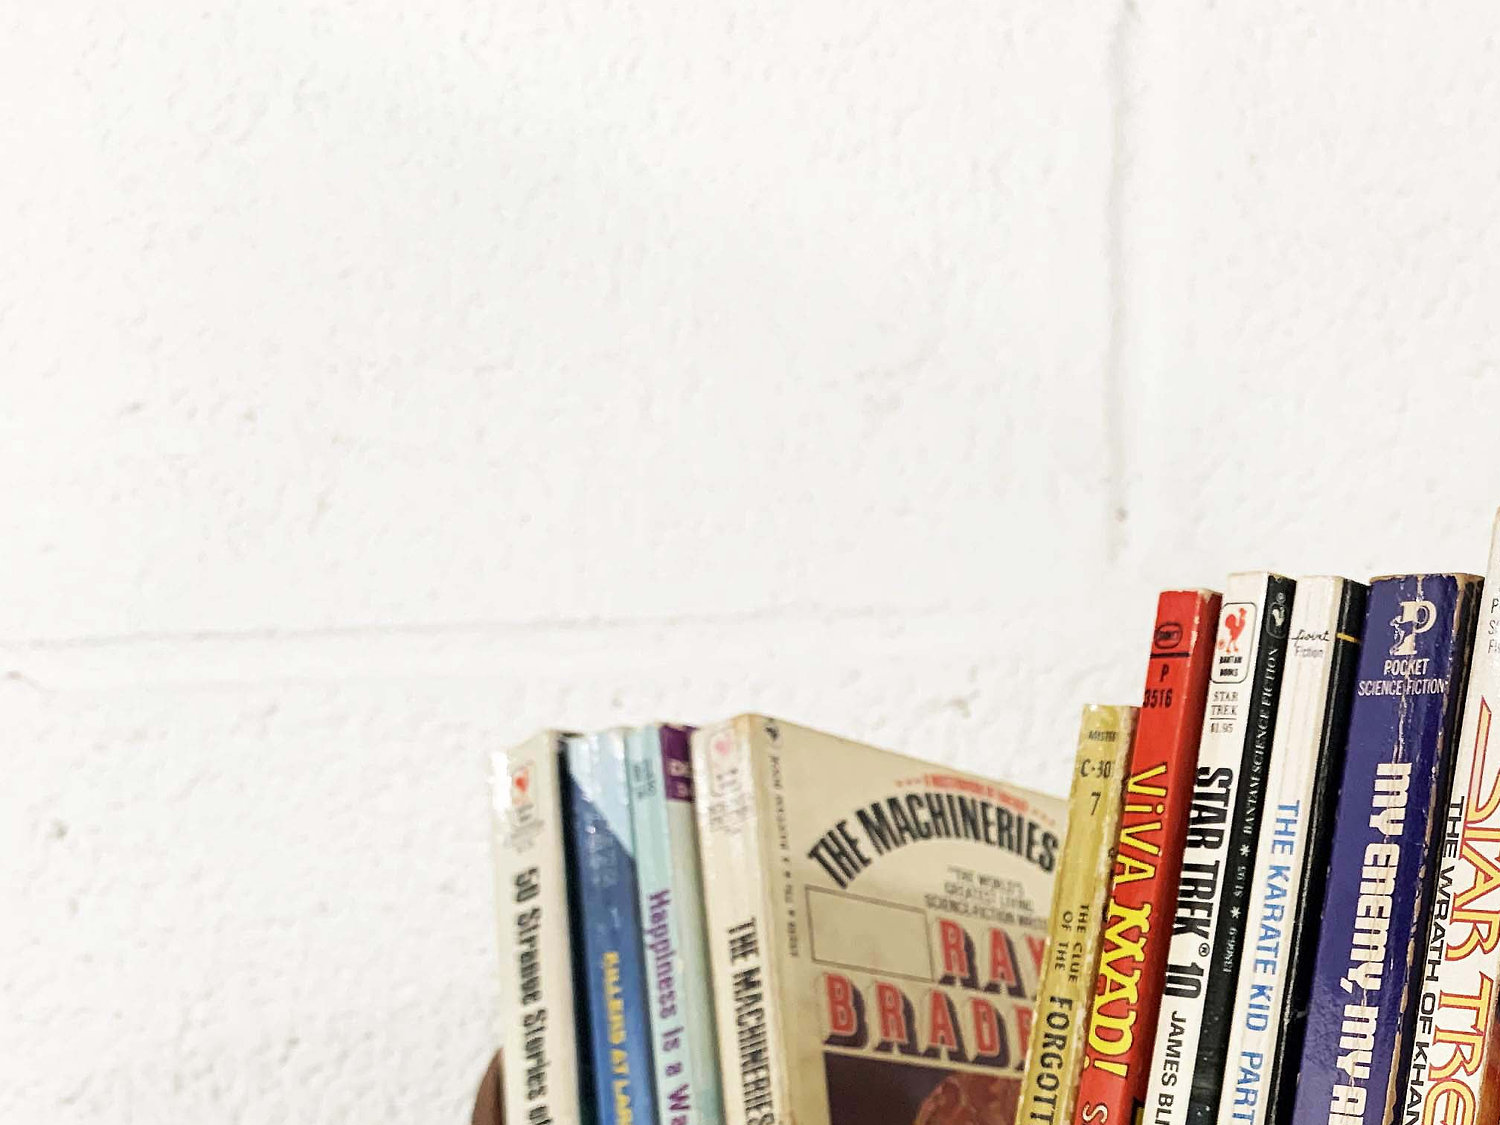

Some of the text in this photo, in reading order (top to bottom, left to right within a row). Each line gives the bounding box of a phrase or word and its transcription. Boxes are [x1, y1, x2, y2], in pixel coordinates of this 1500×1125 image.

[1159, 663, 1169, 683] P
[1219, 655, 1242, 665] BANTAM
[1219, 668, 1240, 677] BOOKS
[1294, 647, 1324, 658] Fiction
[1384, 658, 1430, 675] POCKET
[1143, 688, 1173, 709] 3516
[1213, 691, 1239, 702] STAR
[1358, 678, 1445, 696] SCIENCE FICTION
[1210, 705, 1237, 716] TREK
[1243, 648, 1279, 835] BANTAM SCIENCE FICTION
[1090, 791, 1102, 816] 7
[1187, 766, 1234, 849] STAR
[807, 819, 872, 890] THE
[855, 792, 1060, 873] MACHINERIES
[1271, 800, 1300, 856] THE
[1445, 795, 1465, 858] THE
[513, 866, 541, 903] 50
[727, 917, 759, 967] THE
[1054, 911, 1074, 970] OF THE
[1252, 865, 1290, 975] KARATE
[1426, 865, 1456, 982] WRATH
[517, 906, 545, 1005] Strange
[644, 889, 679, 1019] Happiness
[1069, 904, 1090, 983] THE CLUE
[1165, 962, 1204, 999] 10
[1245, 983, 1273, 1032] KID
[1418, 993, 1436, 1034] OF
[521, 1008, 551, 1101] Stories
[610, 1048, 631, 1075] AT
[661, 1025, 685, 1053] Is
[1162, 1010, 1187, 1087] JAMES
[665, 1061, 683, 1077] a
[1232, 1051, 1264, 1125] PART
